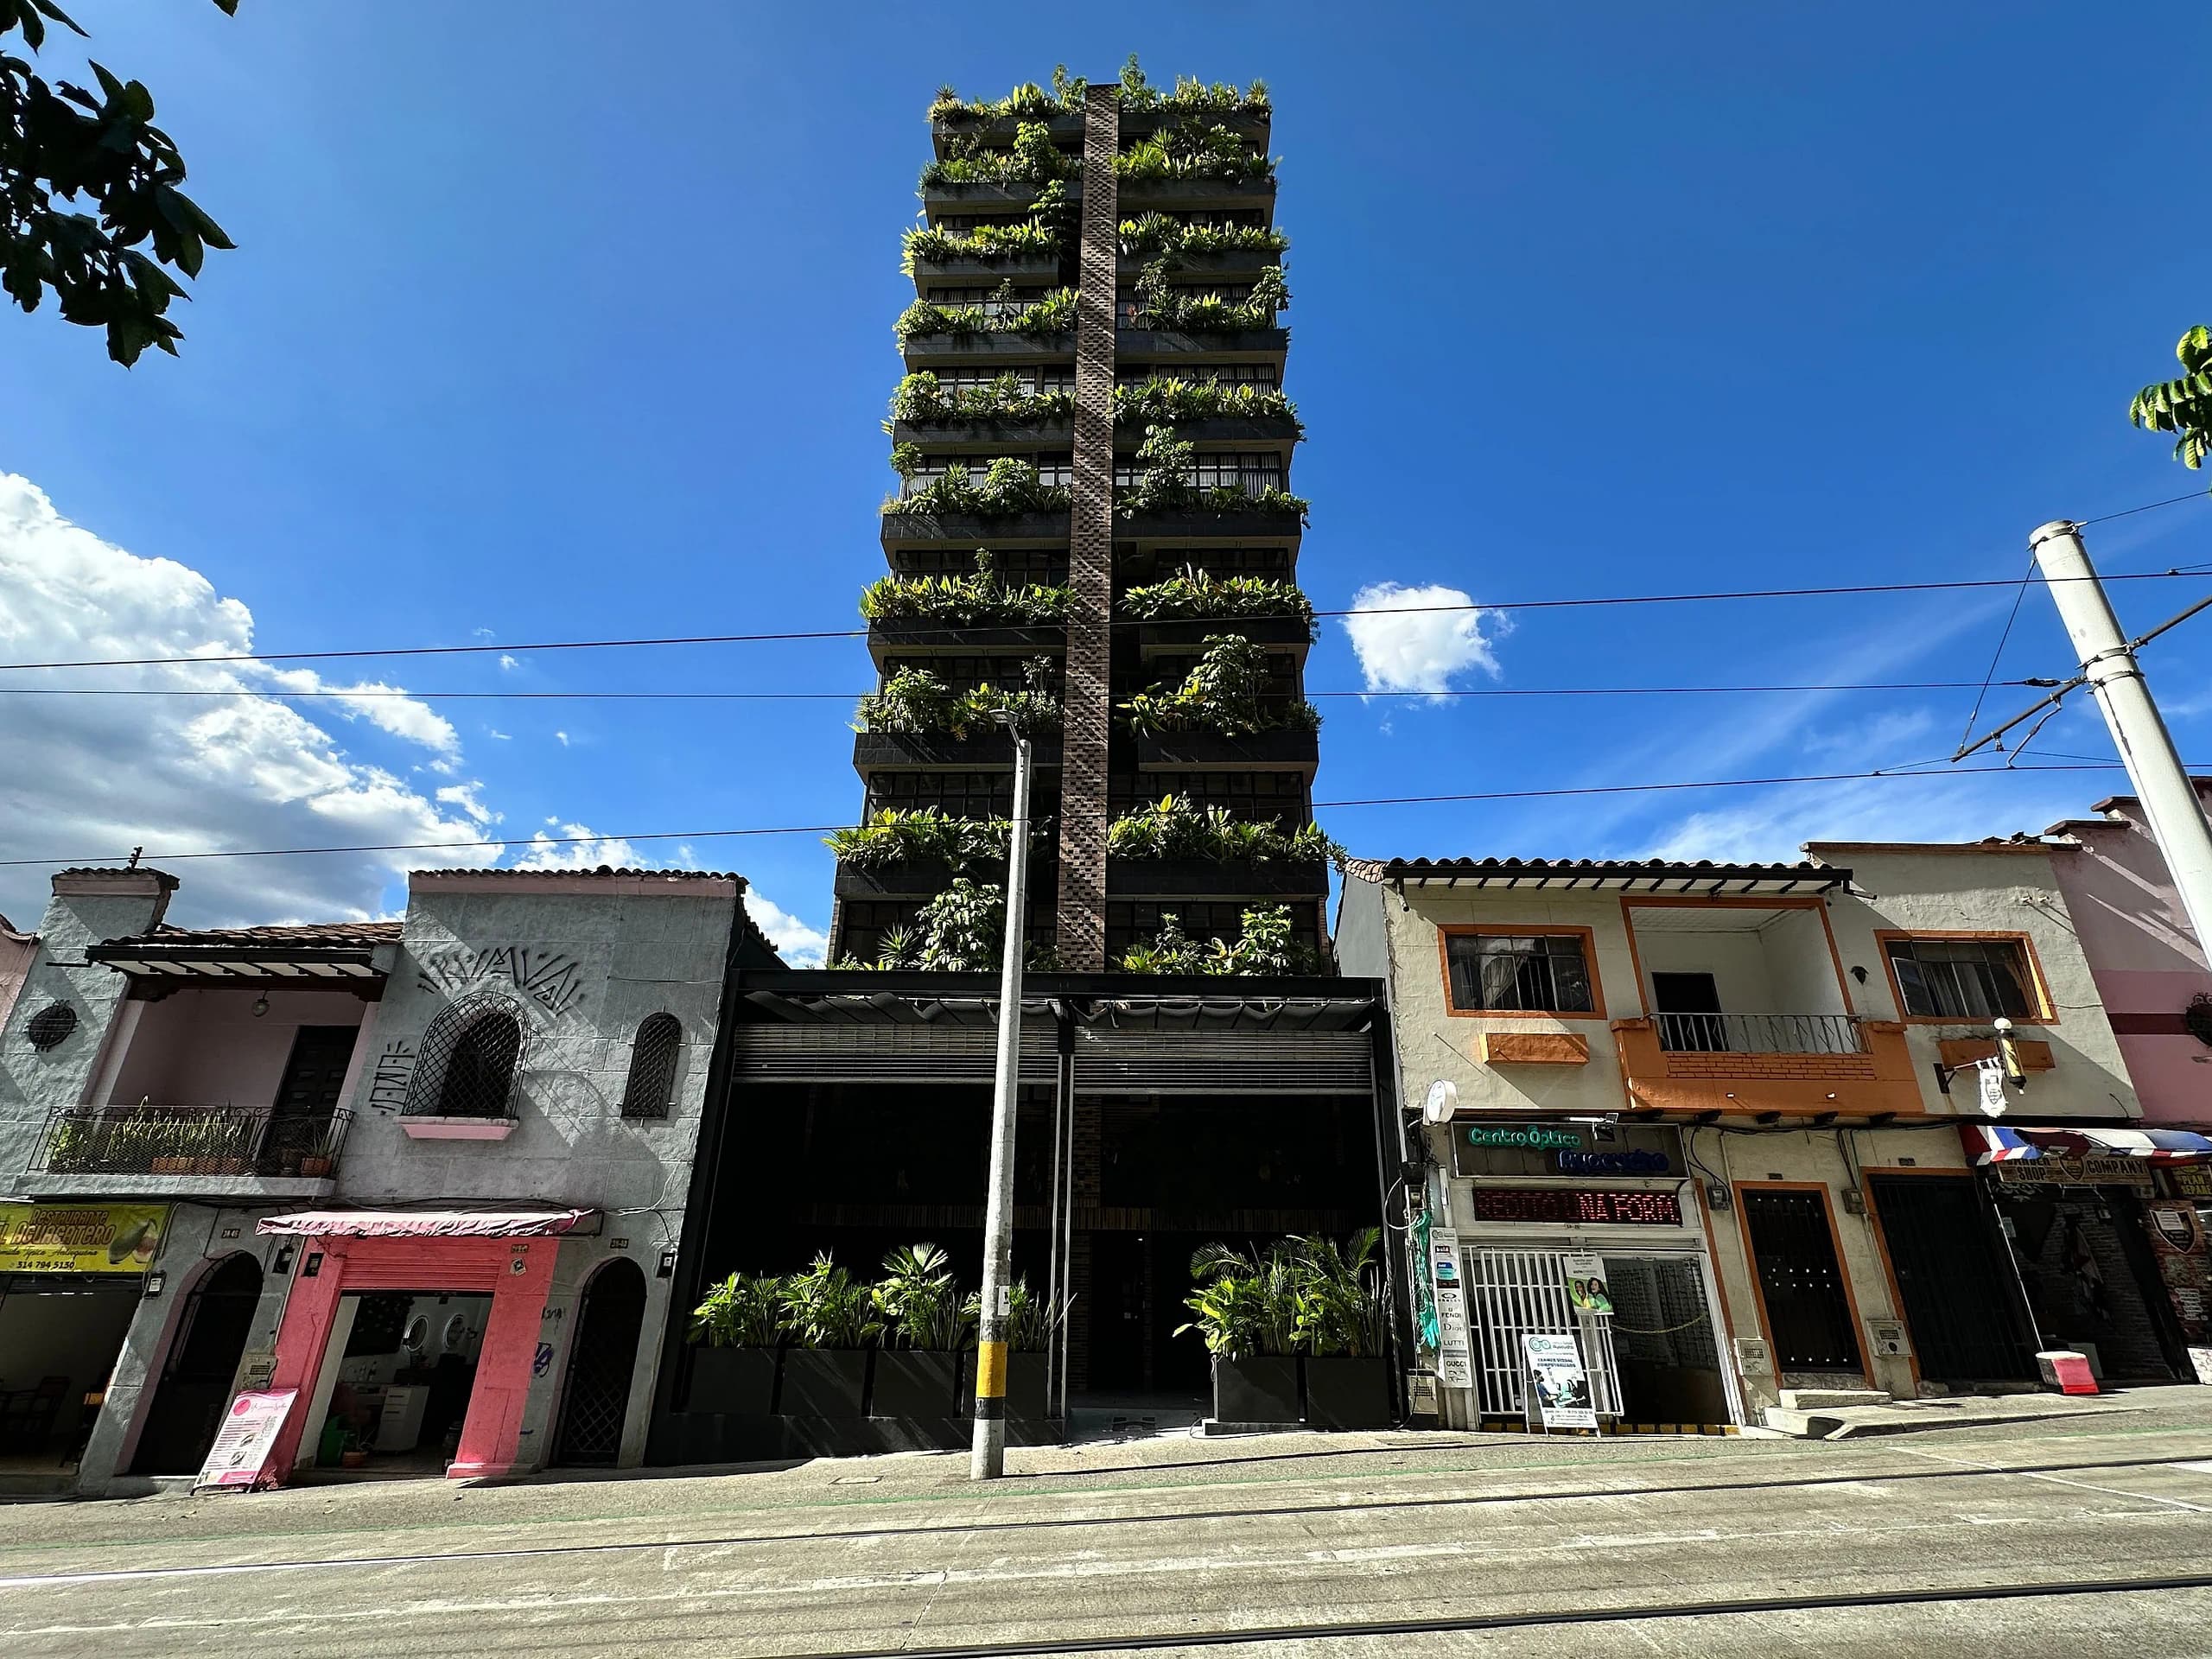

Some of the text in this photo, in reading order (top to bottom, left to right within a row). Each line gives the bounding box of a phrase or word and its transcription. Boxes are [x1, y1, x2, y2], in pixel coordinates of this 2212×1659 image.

[1469, 1124, 1581, 1150] Centro Óptico
[2017, 1166, 2047, 1181] SHOP
[2086, 1159, 2145, 1174] COMPANY
